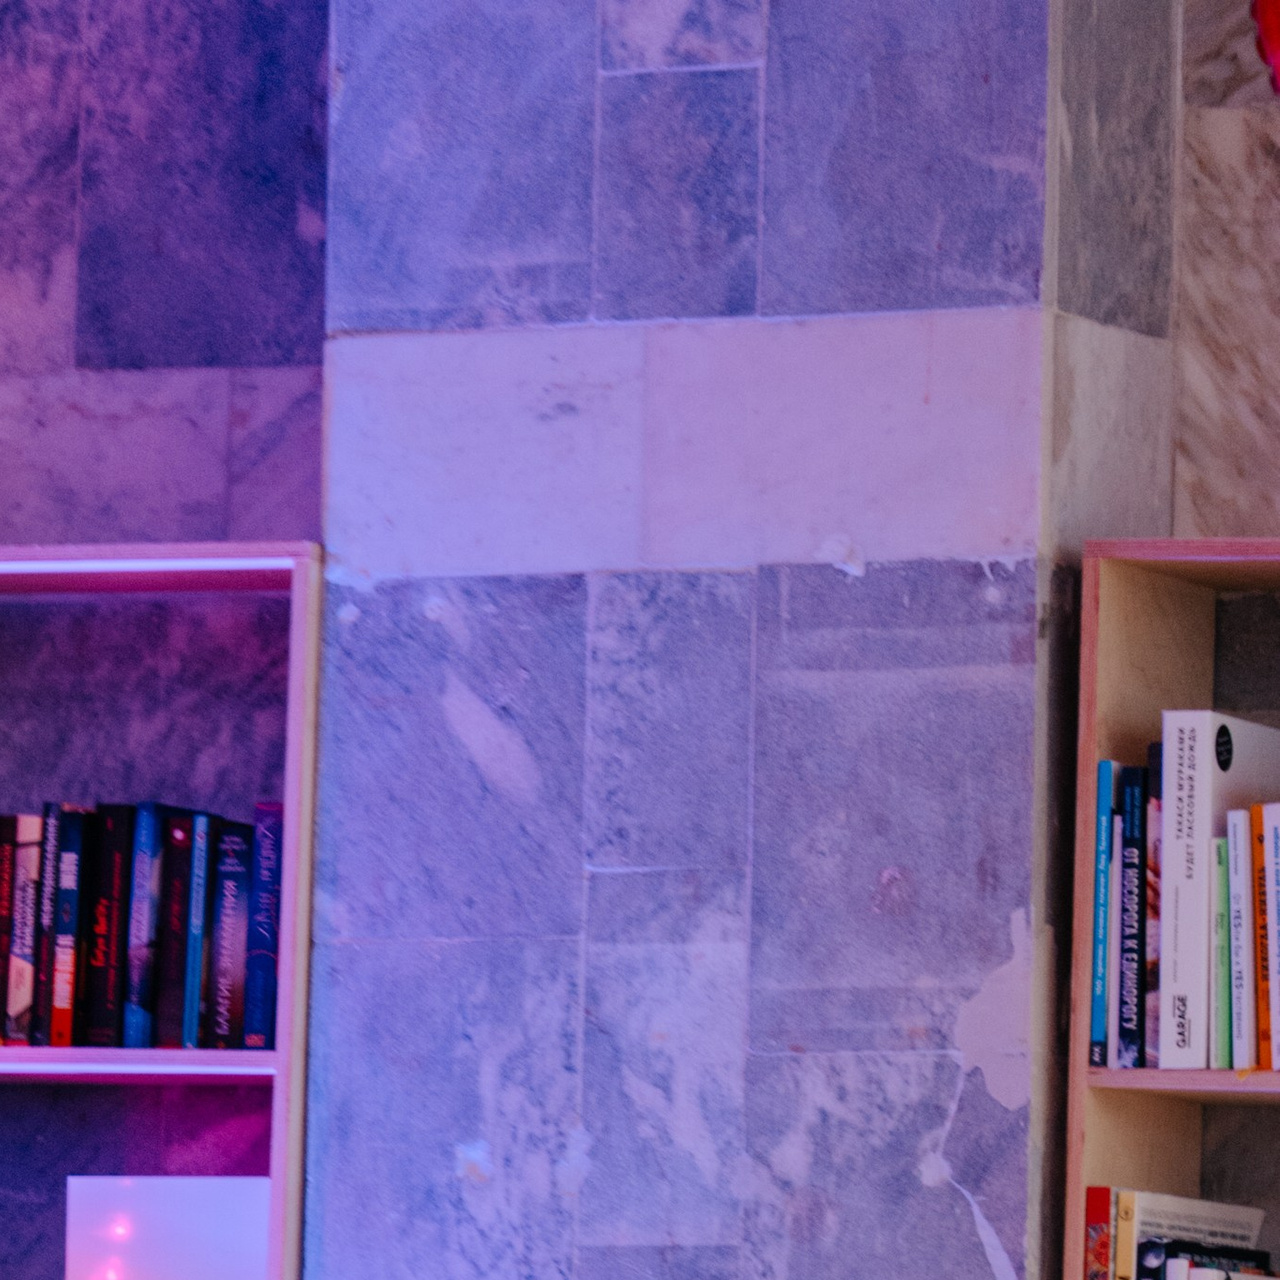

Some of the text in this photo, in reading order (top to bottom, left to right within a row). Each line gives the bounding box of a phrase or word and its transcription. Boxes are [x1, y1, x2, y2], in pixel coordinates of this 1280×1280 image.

[1123, 847, 1139, 864] ОТ
[1122, 868, 1139, 935] НОСОРОГА
[1120, 953, 1138, 1031] ЕДИНОРОГУ
[1175, 994, 1189, 1049] GARAGE
